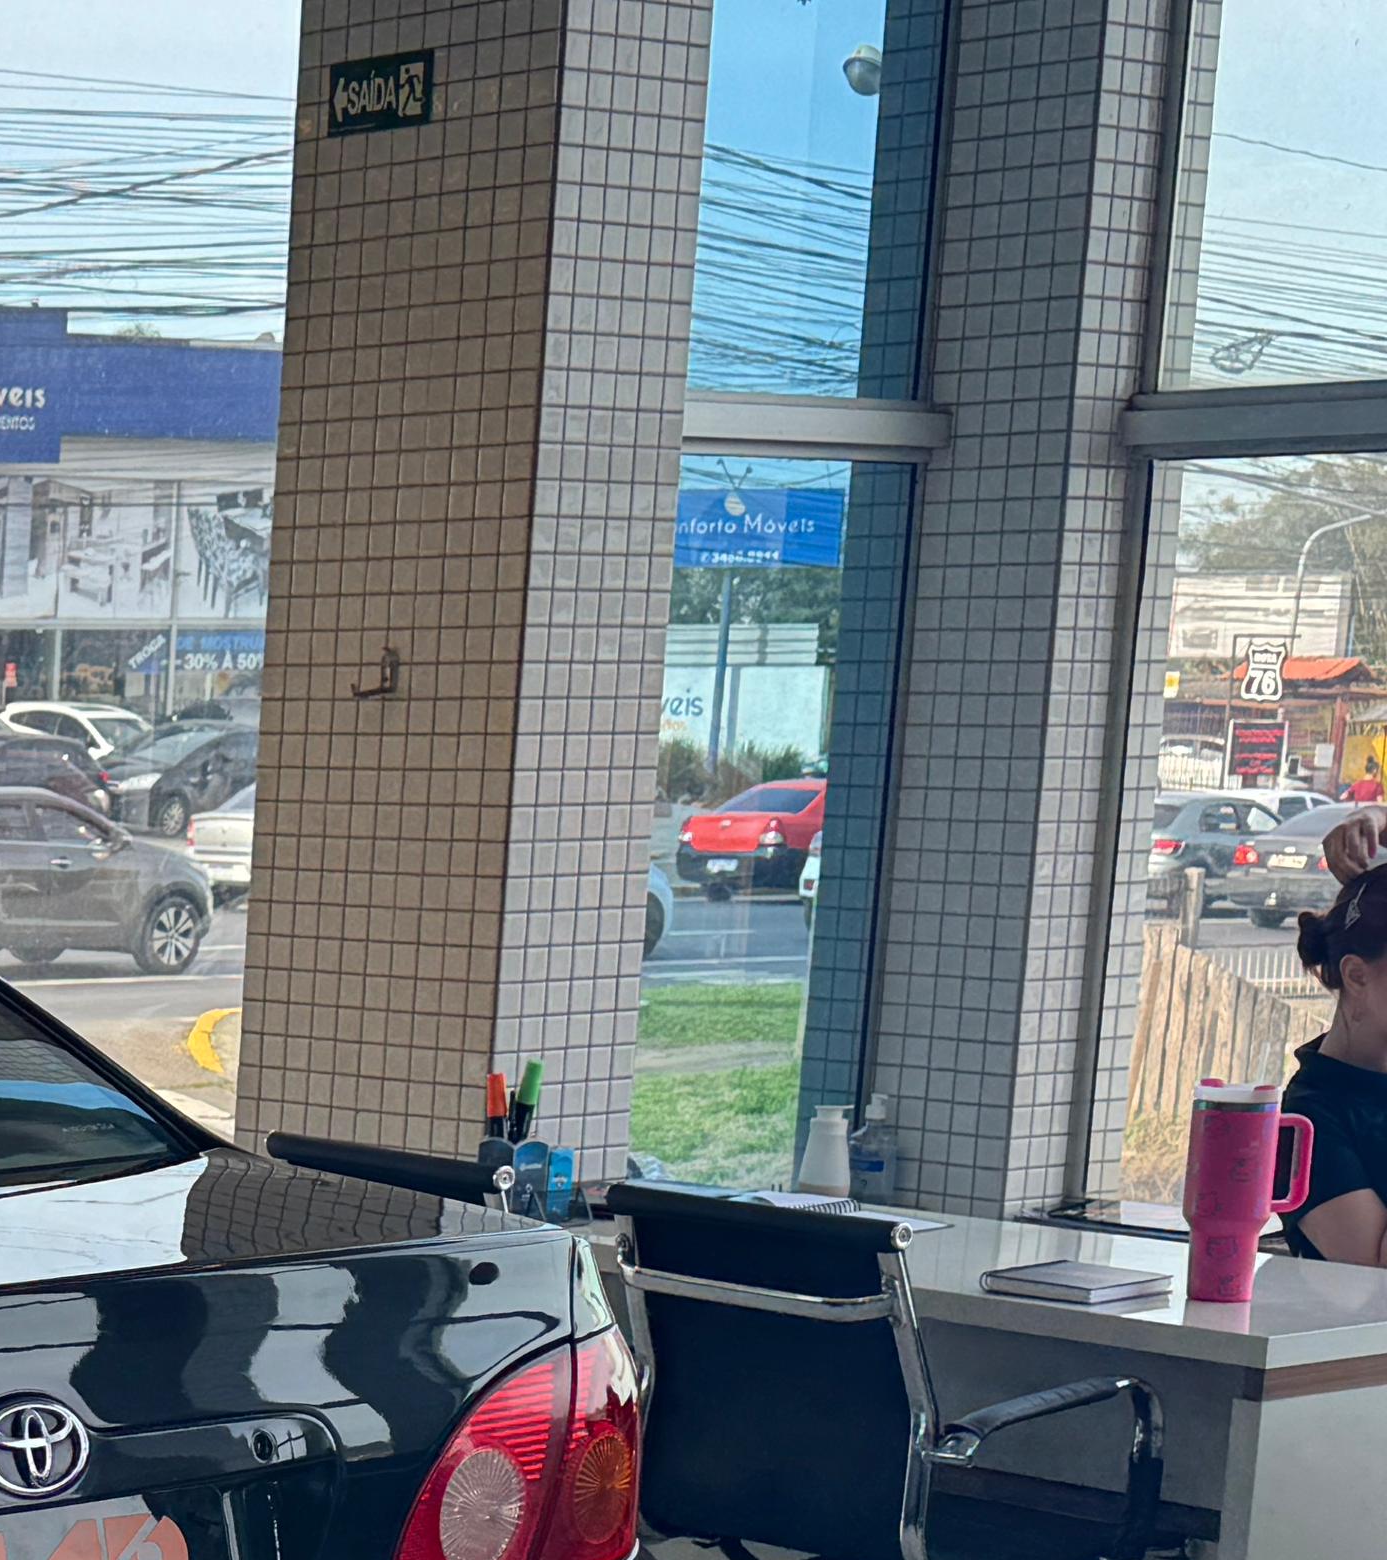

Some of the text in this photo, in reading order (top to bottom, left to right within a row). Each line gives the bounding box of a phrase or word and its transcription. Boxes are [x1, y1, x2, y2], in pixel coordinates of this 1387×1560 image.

[348, 70, 396, 115] SAÍDA
[678, 512, 815, 534] nforto Móveis
[128, 634, 167, 669] TROCA
[201, 634, 265, 651] MOSTRU
[184, 652, 219, 671] 30%
[1250, 671, 1276, 695] 76
